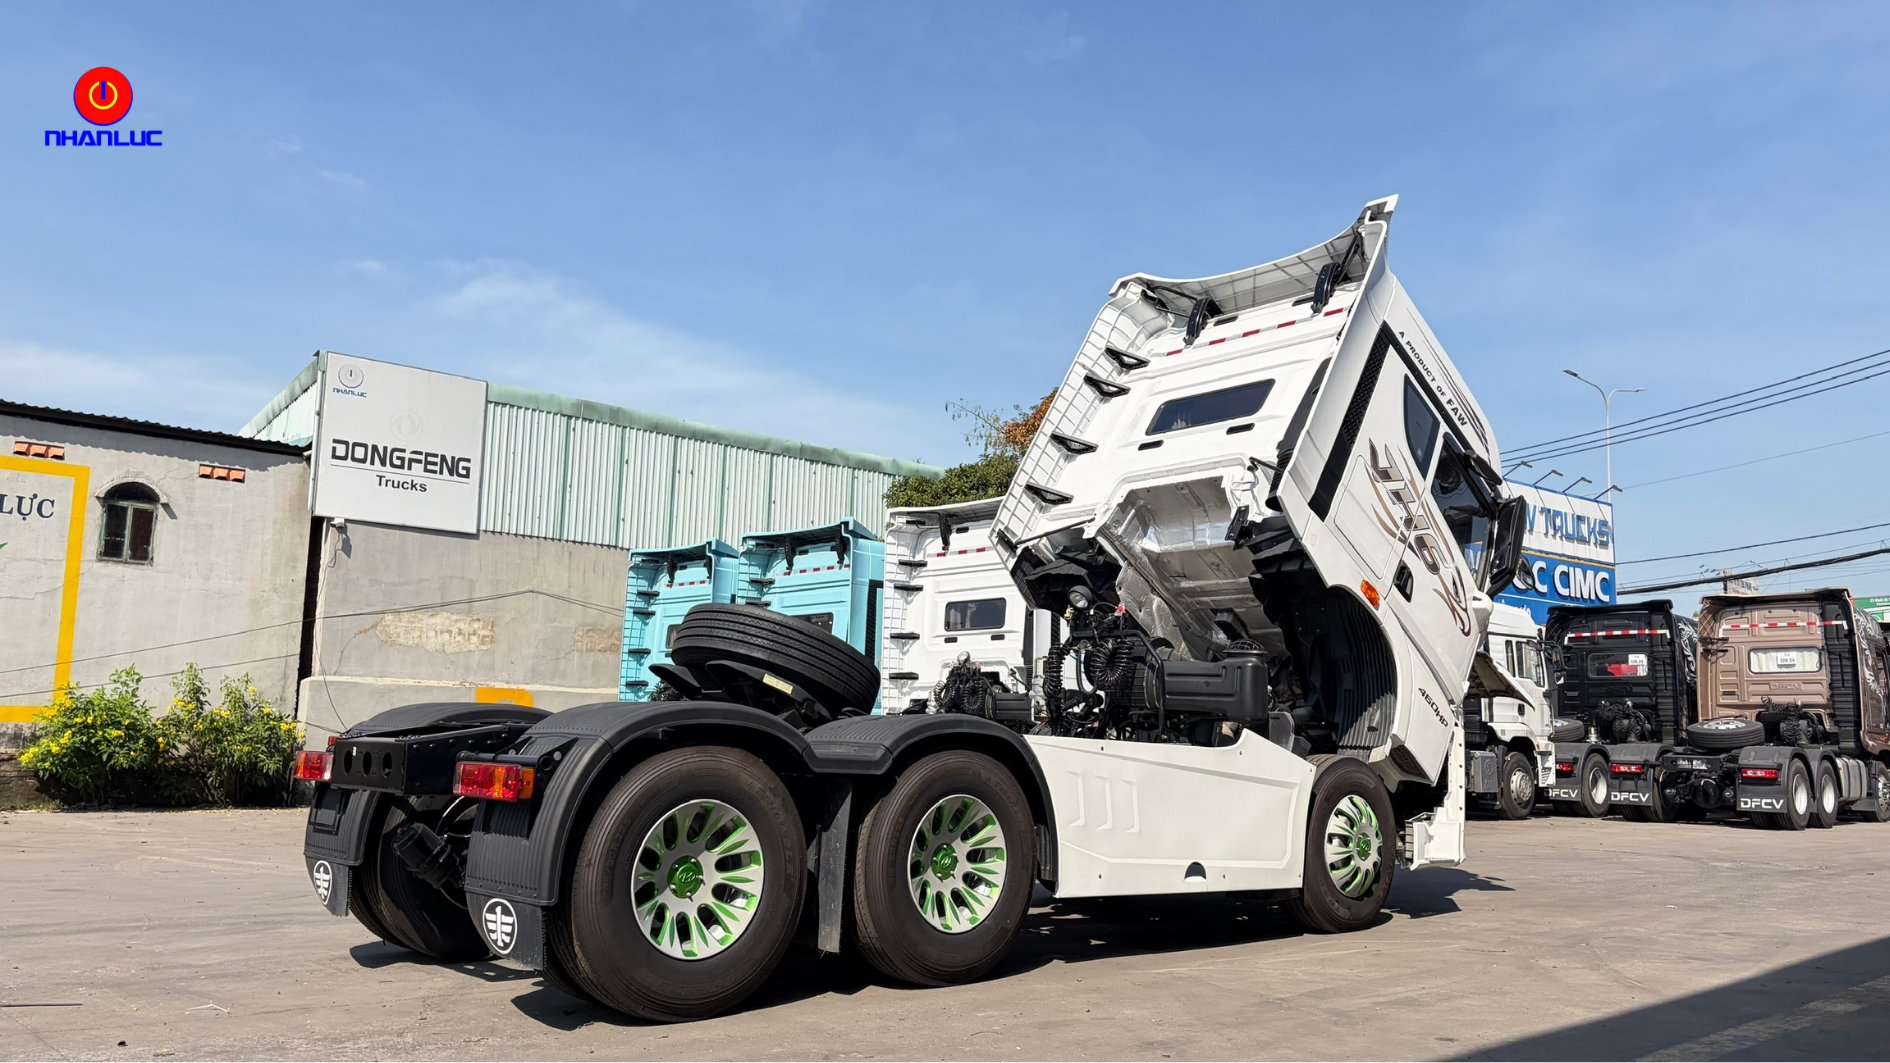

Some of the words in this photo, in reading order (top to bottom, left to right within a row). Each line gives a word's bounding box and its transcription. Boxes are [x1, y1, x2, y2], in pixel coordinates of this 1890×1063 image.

[1398, 331, 1406, 339] A
[1405, 340, 1437, 383] PRODUCT
[1436, 385, 1447, 398] OF
[1446, 396, 1469, 427] FAW
[331, 438, 472, 479] DONGFENG
[375, 474, 428, 493] Trucks
[1540, 506, 1611, 547] TRUCKS
[1553, 564, 1610, 603] CIMC
[1418, 687, 1449, 728] 460HP
[1543, 788, 1579, 799] DFCV
[1610, 791, 1650, 803] DFCV
[1740, 797, 1784, 810] DFCV
